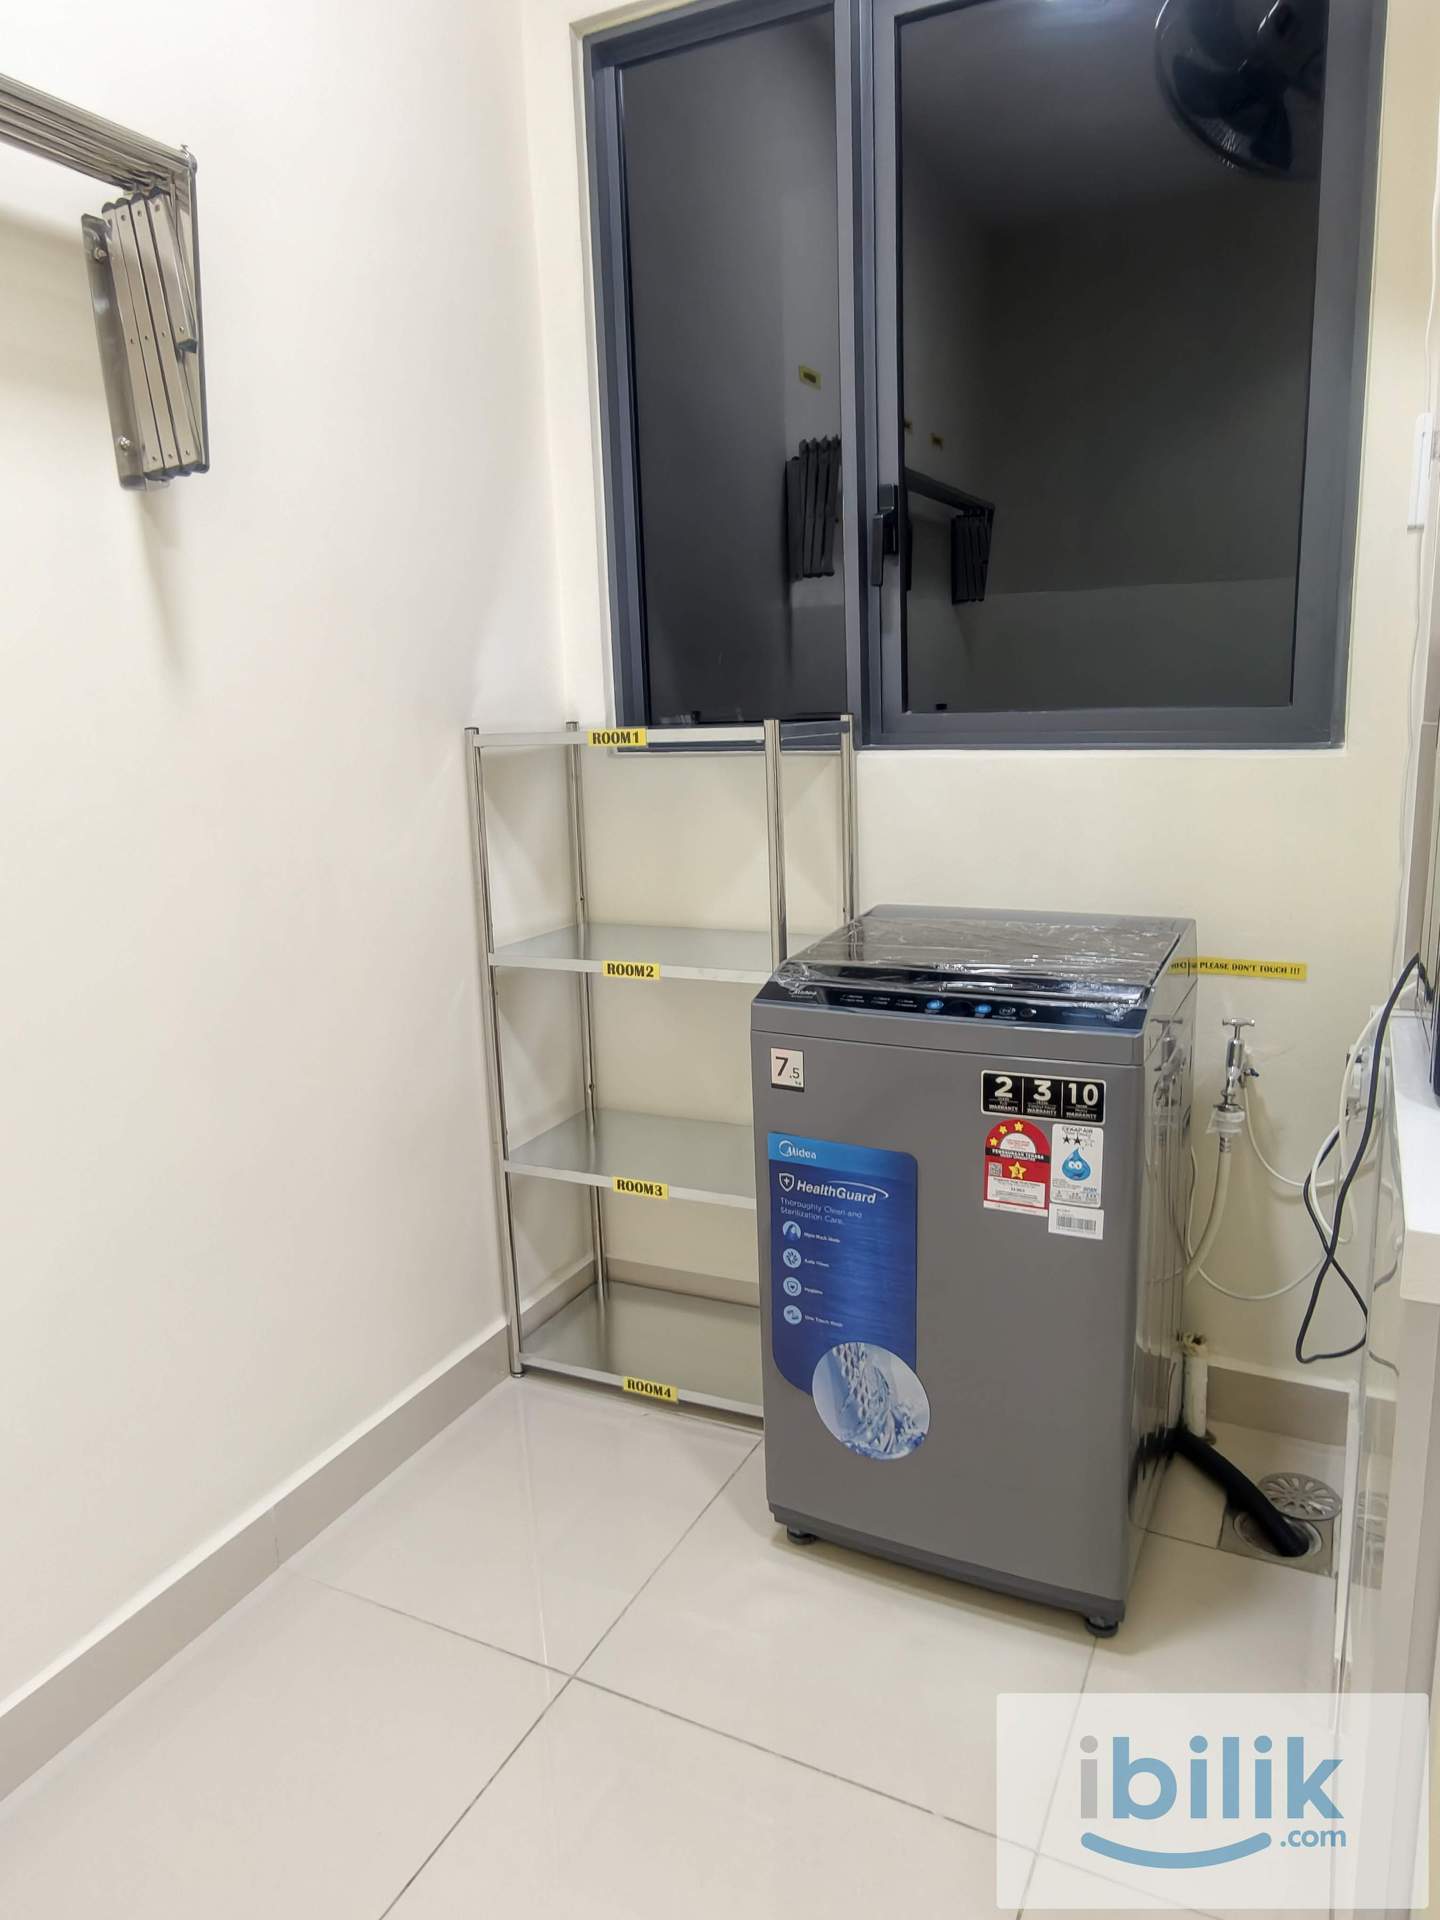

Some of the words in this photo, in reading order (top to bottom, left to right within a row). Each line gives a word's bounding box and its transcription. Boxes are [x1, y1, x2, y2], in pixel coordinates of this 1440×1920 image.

[1200, 962, 1228, 970] PLEASE
[1231, 963, 1256, 972] DON'T
[1260, 965, 1287, 974] TOUCH
[995, 1077, 1013, 1098] 2
[1033, 1080, 1051, 1101] 3
[1068, 1083, 1098, 1106] 10
[989, 1104, 1018, 1112] WARRANTY
[1027, 1108, 1056, 1116] WARRANTY
[1066, 1111, 1097, 1120] WARRANTY
[783, 1144, 816, 1160] Midea
[797, 1180, 876, 1203] HealthGuard
[781, 1197, 821, 1212] Thoroughly
[824, 1205, 845, 1215] Clean
[848, 1210, 862, 1218] and
[781, 1206, 823, 1220] Sterilization
